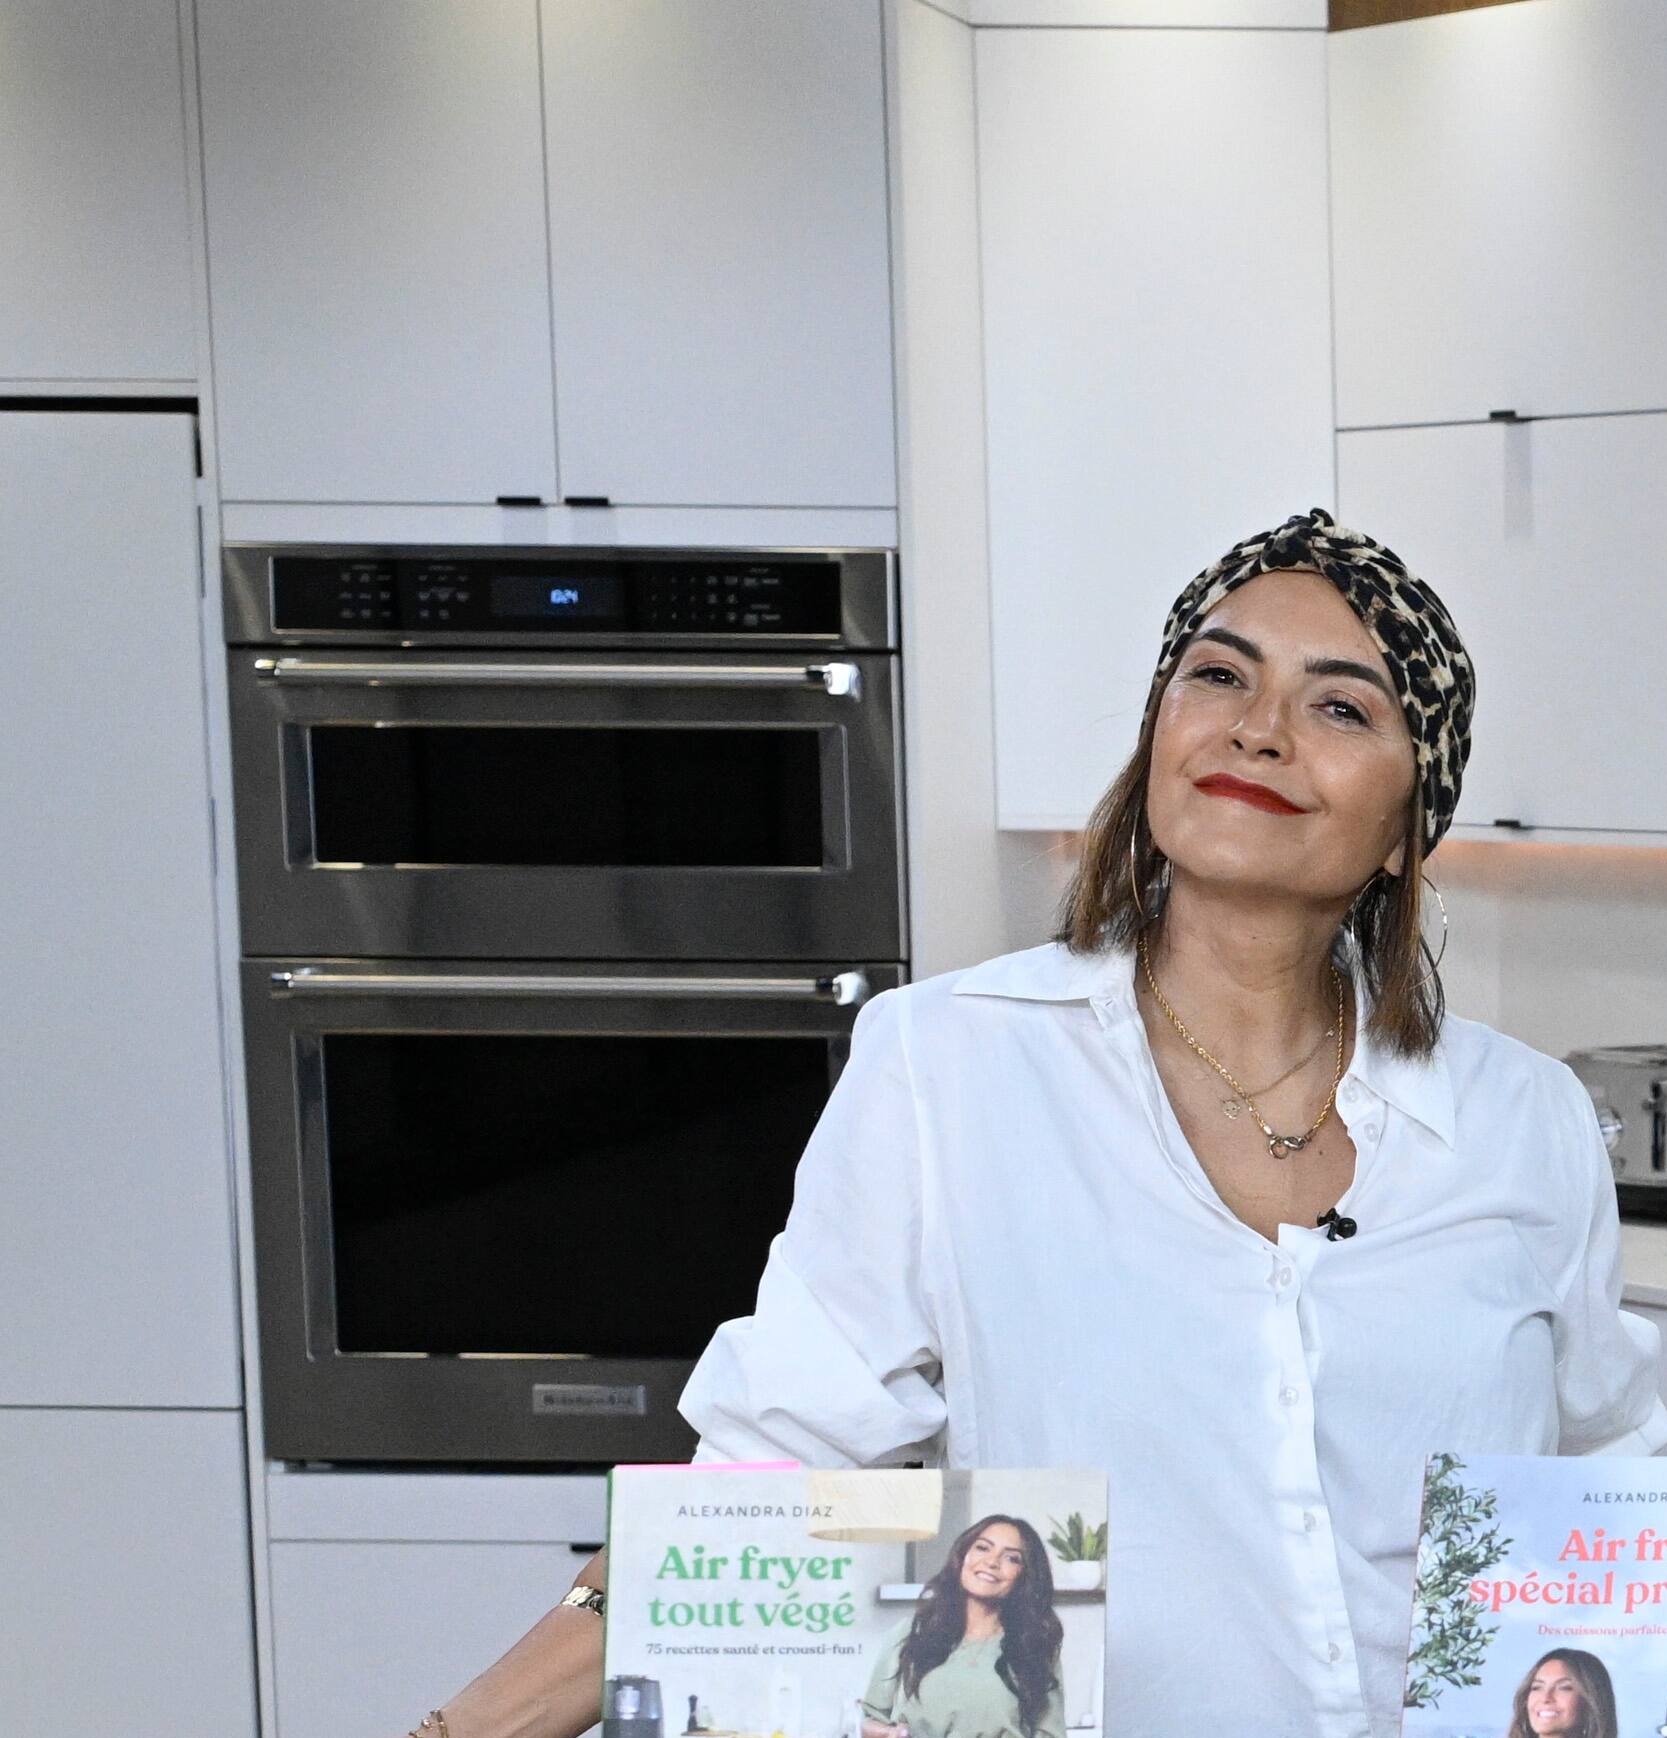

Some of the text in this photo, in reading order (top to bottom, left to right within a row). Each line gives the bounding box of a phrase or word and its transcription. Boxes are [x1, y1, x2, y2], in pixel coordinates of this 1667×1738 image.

[677, 1505, 833, 1518] ALEXANDRA DIAZ
[1558, 1528, 1627, 1562] Air
[656, 1545, 853, 1589] Air fryer
[1470, 1570, 1614, 1613] spécial
[648, 1592, 856, 1633] tout végé
[1538, 1624, 1561, 1636] Des
[1563, 1625, 1618, 1636] cuissons
[646, 1643, 662, 1655] 75
[665, 1643, 720, 1655] recettes
[723, 1642, 760, 1655] santé
[762, 1644, 776, 1655] et
